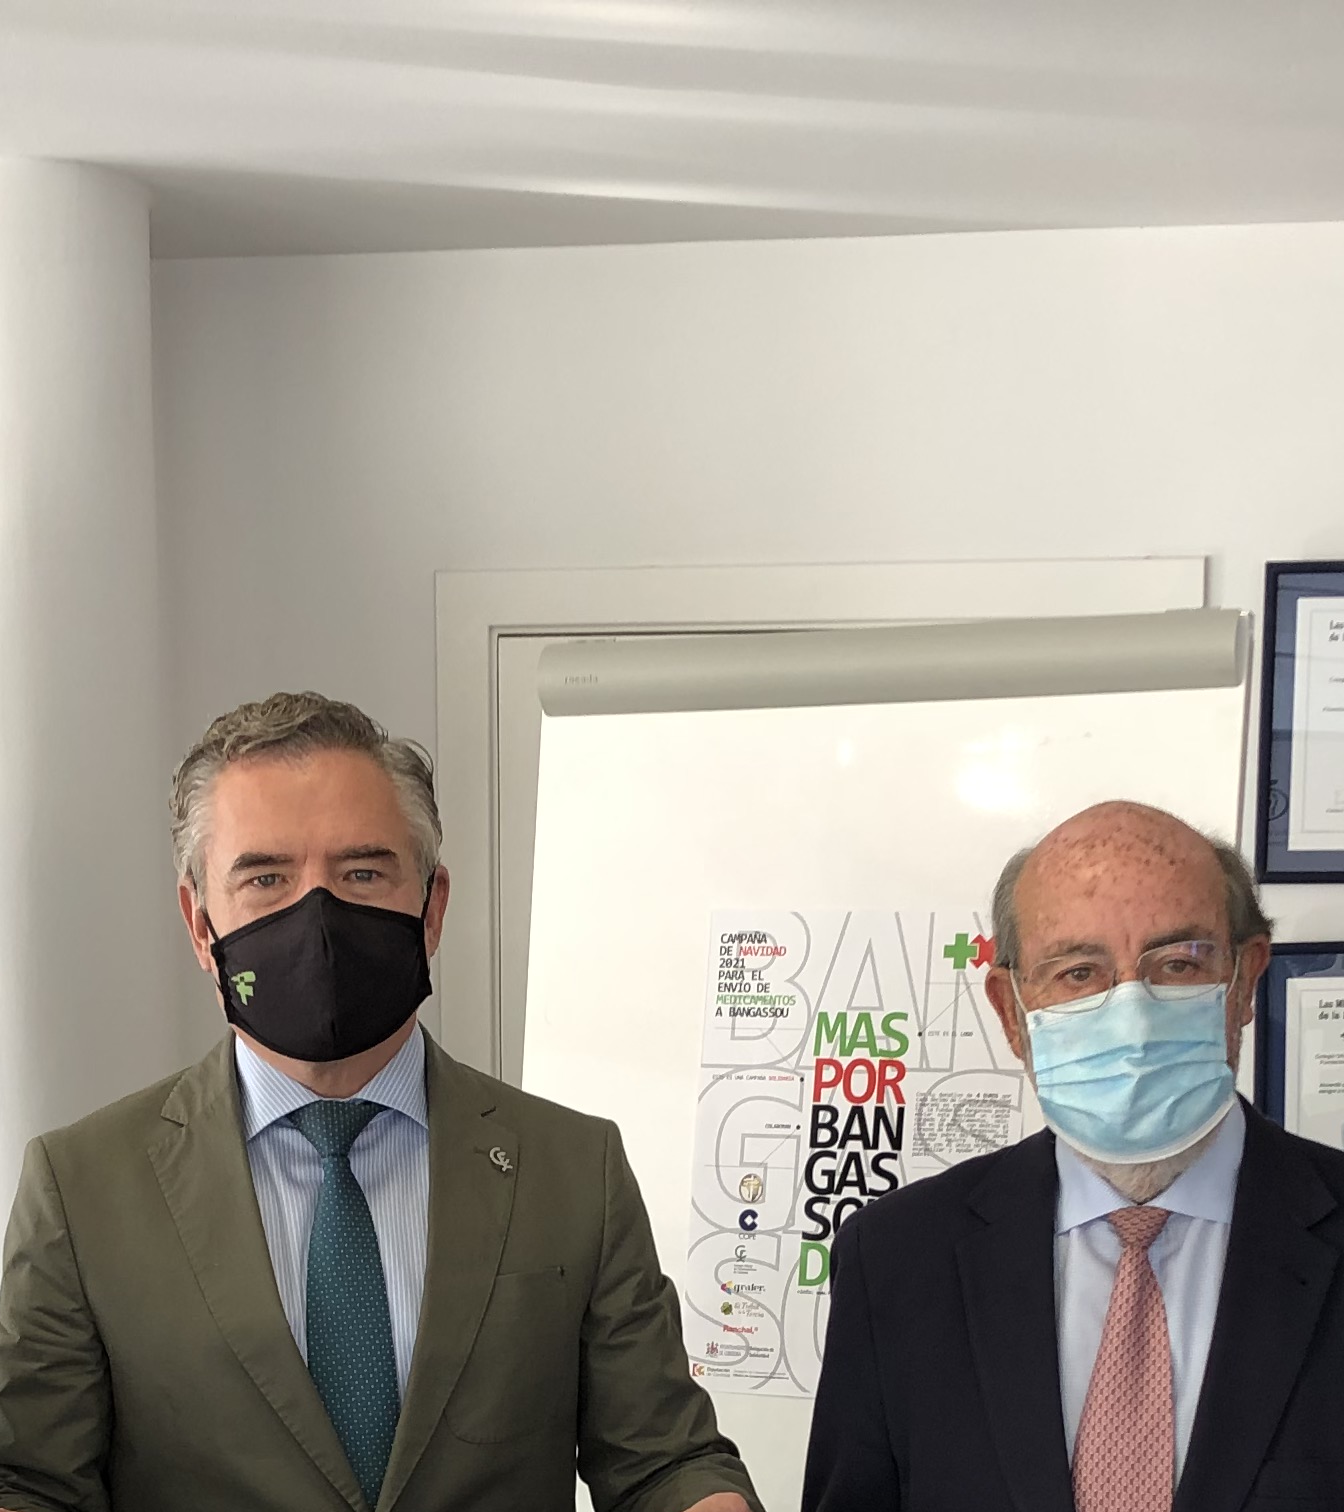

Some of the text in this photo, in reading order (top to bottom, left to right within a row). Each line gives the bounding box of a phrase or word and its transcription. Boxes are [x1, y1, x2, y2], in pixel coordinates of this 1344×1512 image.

[720, 931, 767, 943] CAMPAÑA
[719, 945, 786, 956] DE NAVIDAD
[719, 958, 746, 968] 2021
[718, 970, 764, 980] PARA EL
[717, 980, 770, 992] ENVÍO DE
[716, 995, 796, 1005] MEDICAMENTOS
[715, 1007, 788, 1017] A BANGASSOU
[813, 1010, 911, 1058] MAS
[812, 1057, 909, 1105] POR
[809, 1104, 905, 1151] BAN
[803, 1149, 901, 1198] GAS
